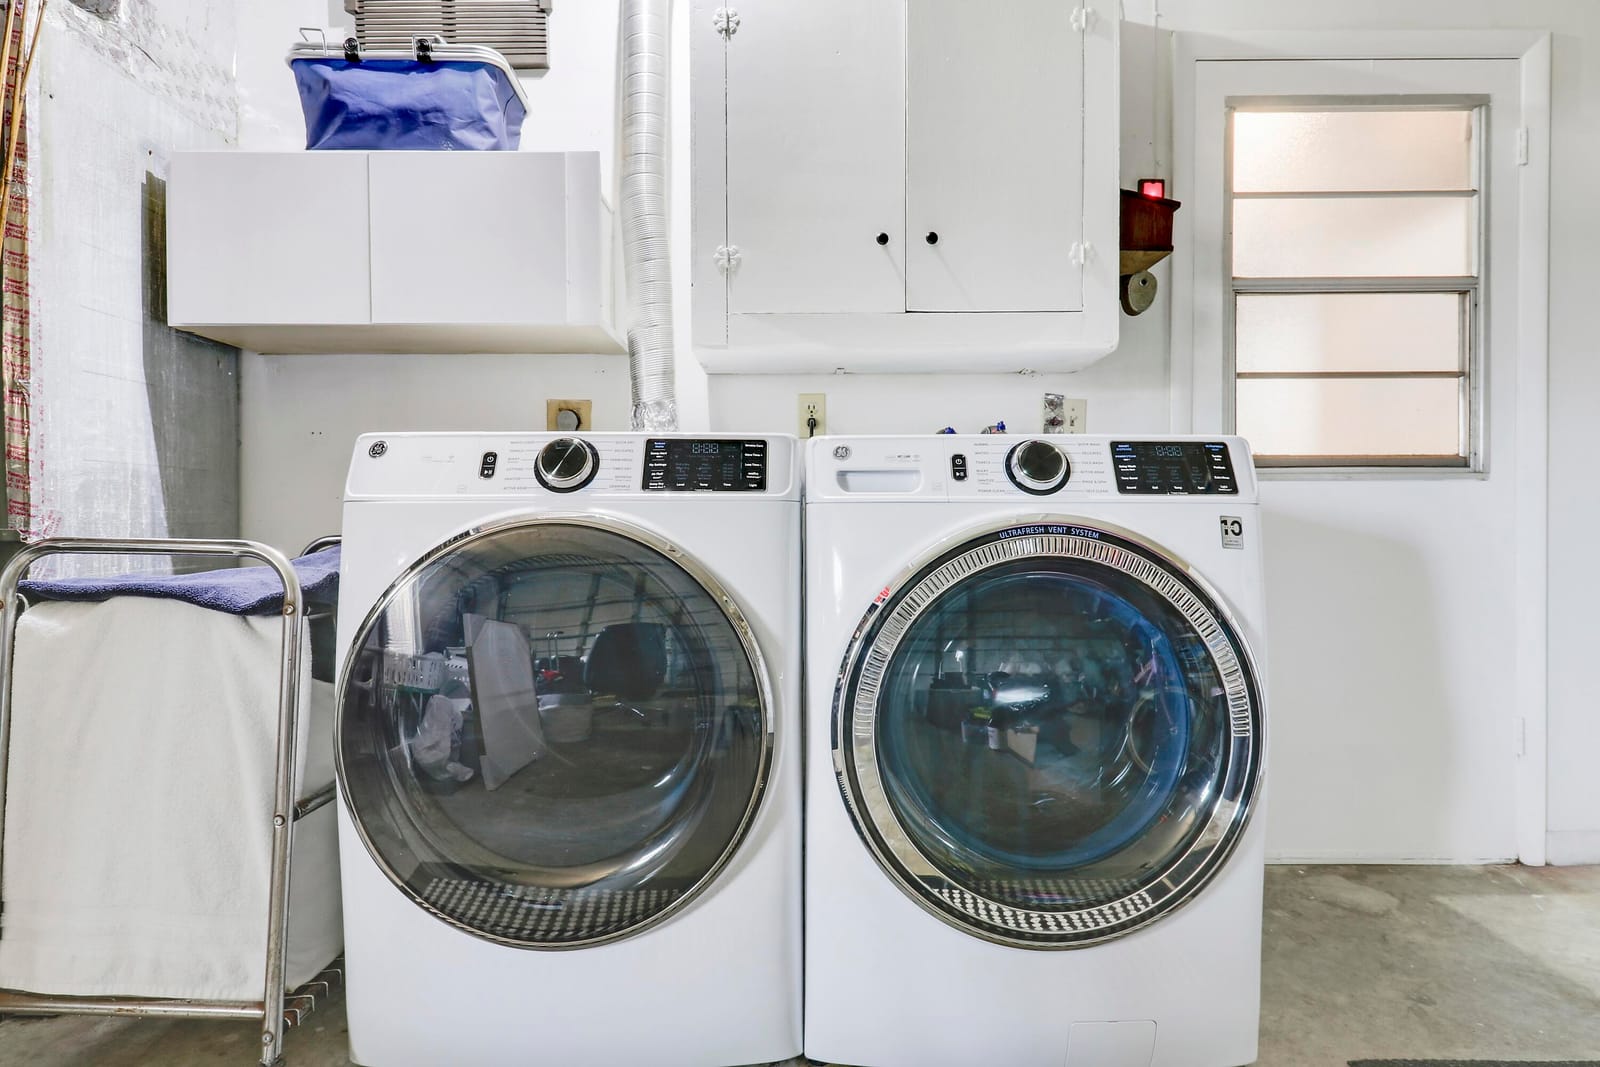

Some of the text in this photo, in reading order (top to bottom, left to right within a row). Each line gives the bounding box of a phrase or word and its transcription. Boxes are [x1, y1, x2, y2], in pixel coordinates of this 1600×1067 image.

[999, 526, 1099, 539] ULTRAFRESH VENT SYSTEM
[1220, 519, 1243, 537] 10
